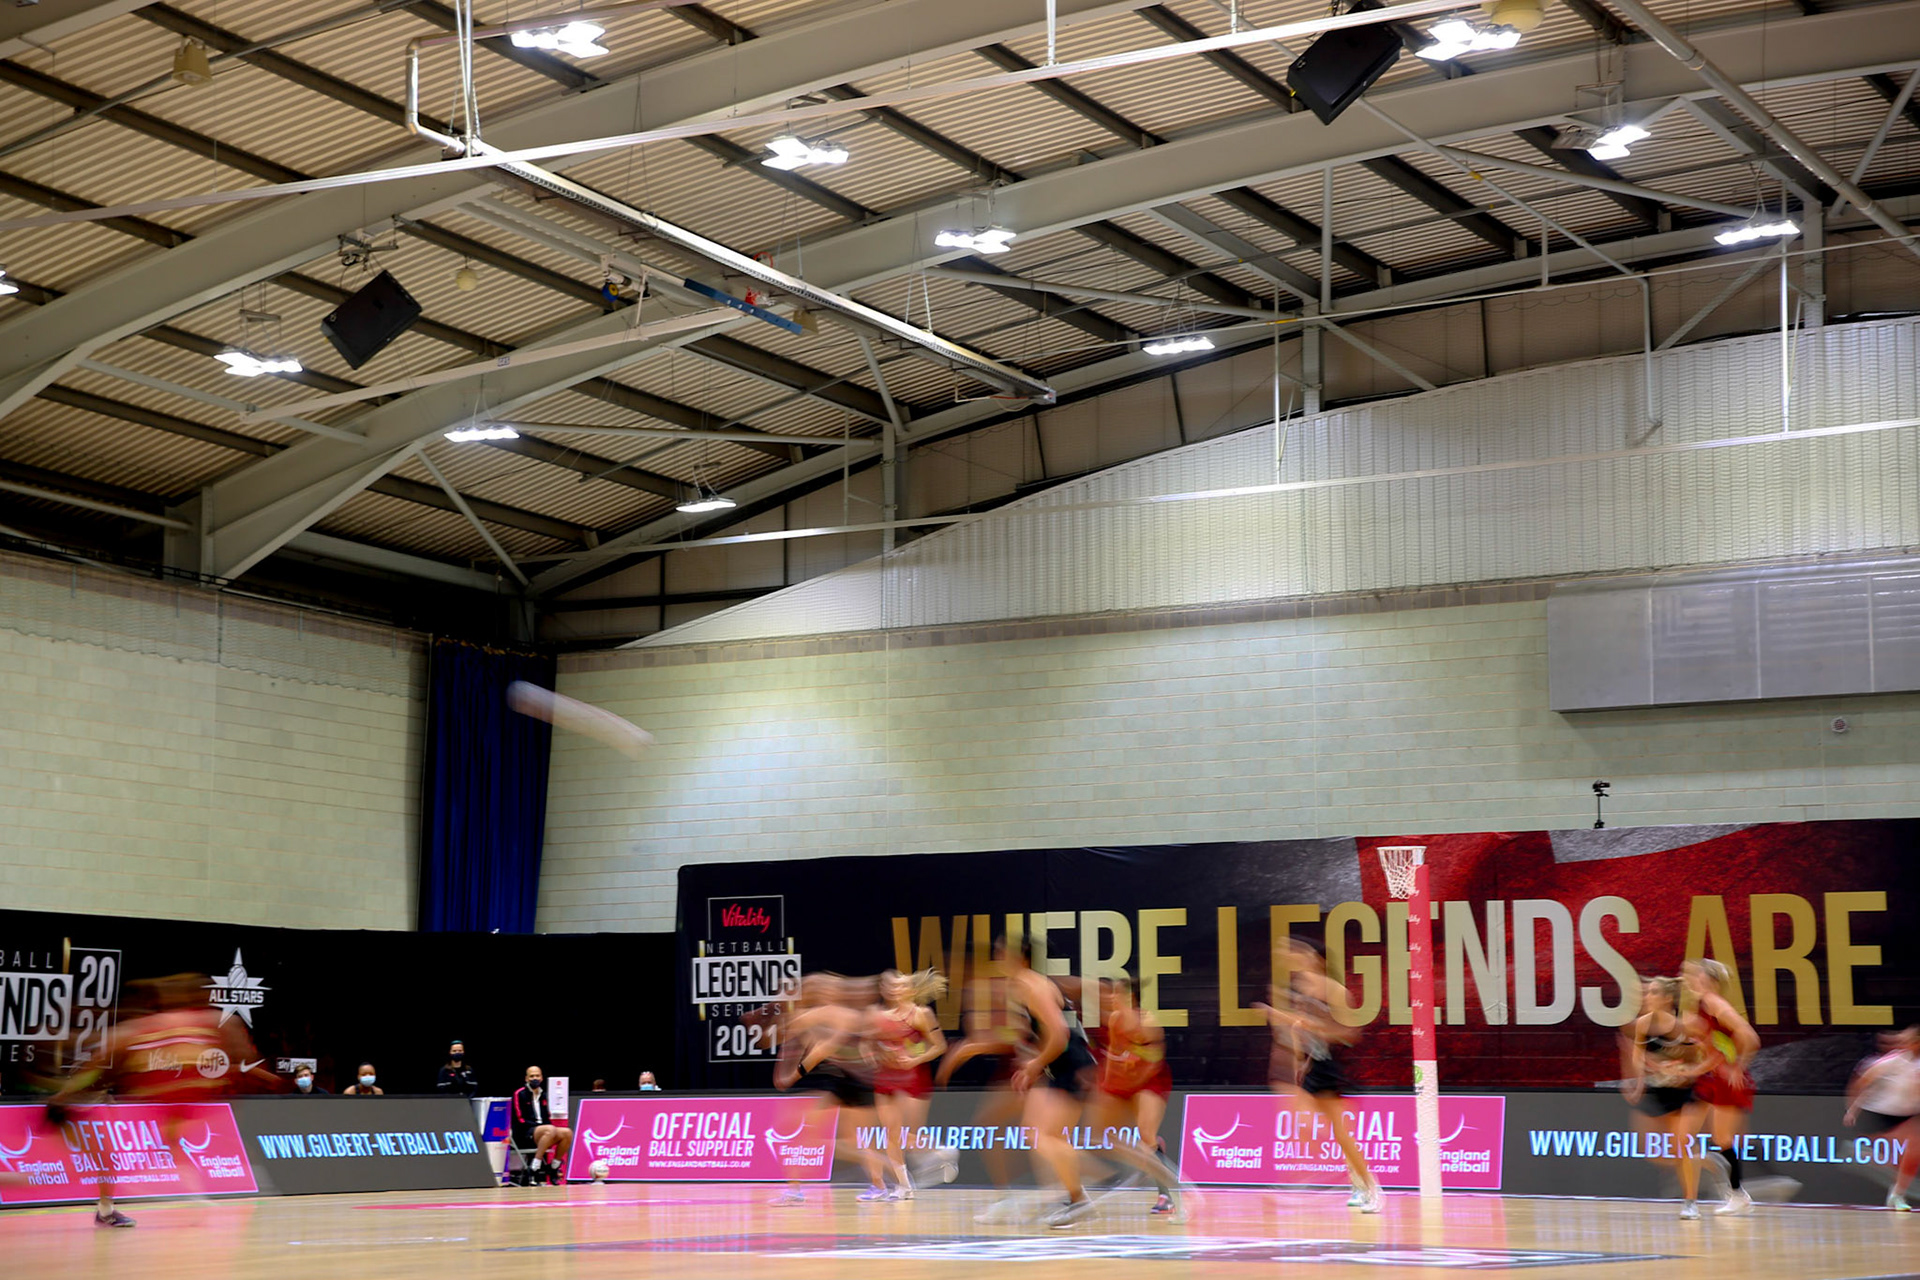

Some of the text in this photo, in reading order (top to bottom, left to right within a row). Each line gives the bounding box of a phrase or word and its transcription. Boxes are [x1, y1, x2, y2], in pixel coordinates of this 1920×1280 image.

[721, 903, 771, 933] Vitality
[706, 941, 787, 954] NETBALL
[891, 891, 1894, 1031] WHERE LEGENDS ARE
[77, 955, 116, 1008] 20
[695, 959, 799, 998] LEGENDS
[209, 989, 265, 1004] ALL STARS
[0, 977, 67, 1036] NDS
[711, 1003, 781, 1017] SERIES
[74, 1009, 109, 1061] 21
[716, 1023, 779, 1057] 2021
[0, 1044, 36, 1062] ES
[652, 1112, 756, 1139] OFFICIAL
[61, 1120, 171, 1152] OFFICIAL
[257, 1131, 479, 1159] WWW.GILBERT-NETBALL.COM
[597, 1145, 641, 1158] England
[649, 1139, 755, 1157] BALL SUPPLIER
[779, 1145, 826, 1158] England
[1211, 1145, 1262, 1159] England
[1273, 1141, 1401, 1160] BALL SUPLIER
[18, 1160, 65, 1174] England
[71, 1151, 177, 1173] BALL SUPPLIER
[200, 1155, 242, 1168] England
[783, 1154, 824, 1166] netball
[1215, 1156, 1262, 1169] netball
[1441, 1161, 1490, 1172] netball
[28, 1171, 69, 1185] netball
[208, 1166, 246, 1178] netball
